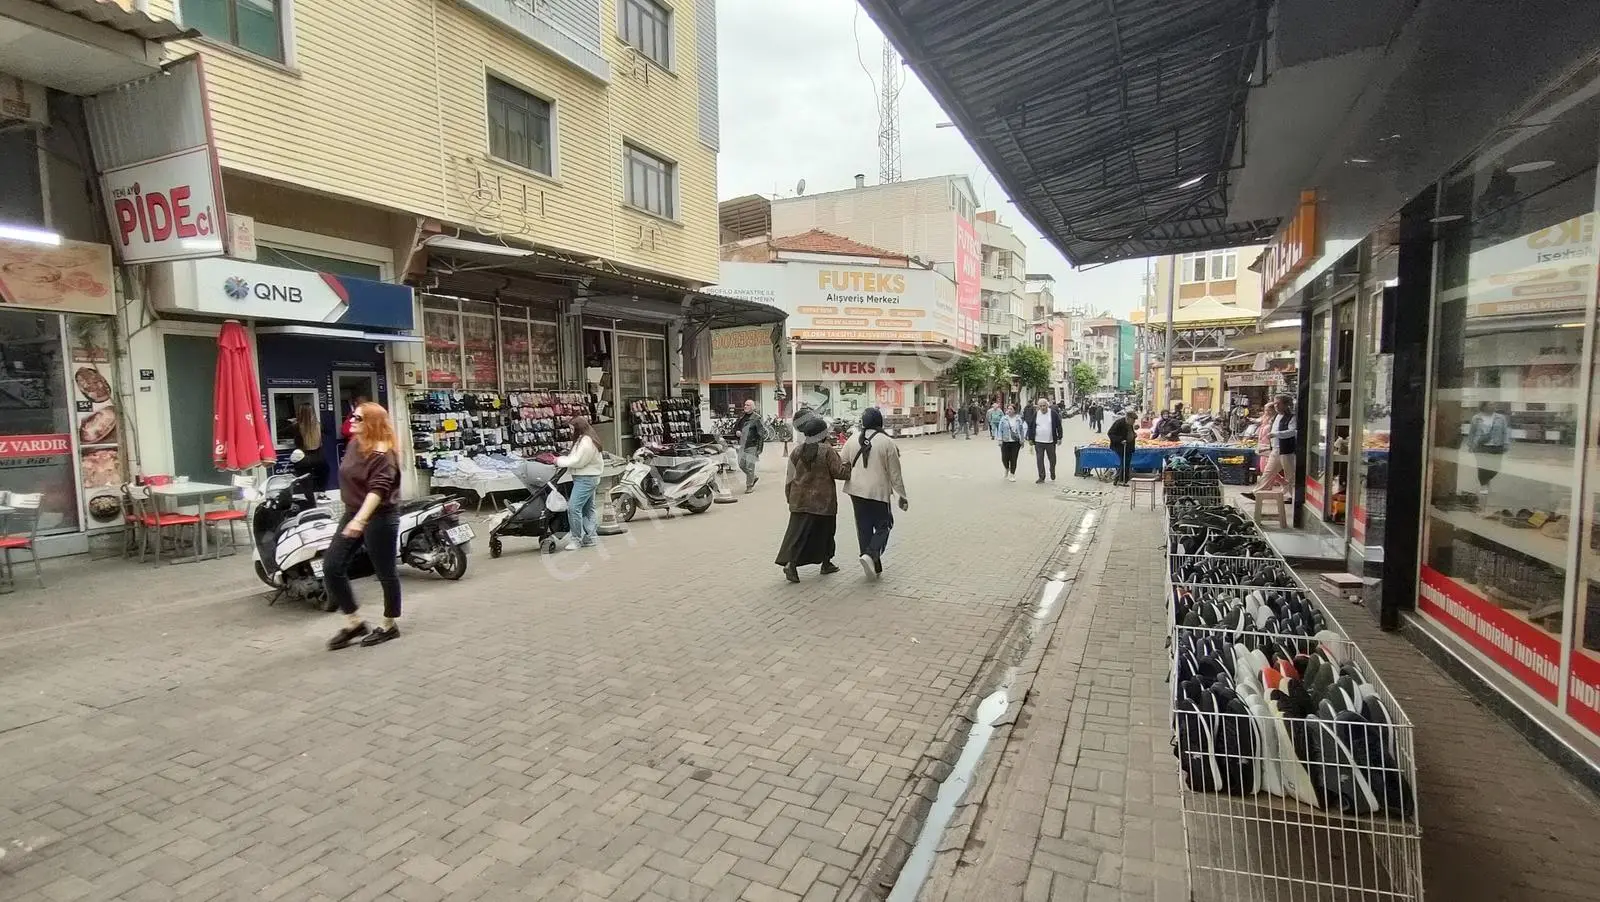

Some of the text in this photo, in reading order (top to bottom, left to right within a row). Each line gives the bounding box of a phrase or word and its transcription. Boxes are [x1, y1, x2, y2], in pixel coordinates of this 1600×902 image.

[818, 270, 905, 293] FUTEKS
[254, 282, 302, 303] QNB
[826, 293, 899, 304] Alışveriş Merkezi
[821, 361, 876, 374] FUTEKS
[10, 439, 69, 452] VARDIR
[1446, 593, 1476, 631] İNDİRİM
[1476, 612, 1514, 655] İNDİRİM
[1514, 636, 1559, 686] İNDİRİM
